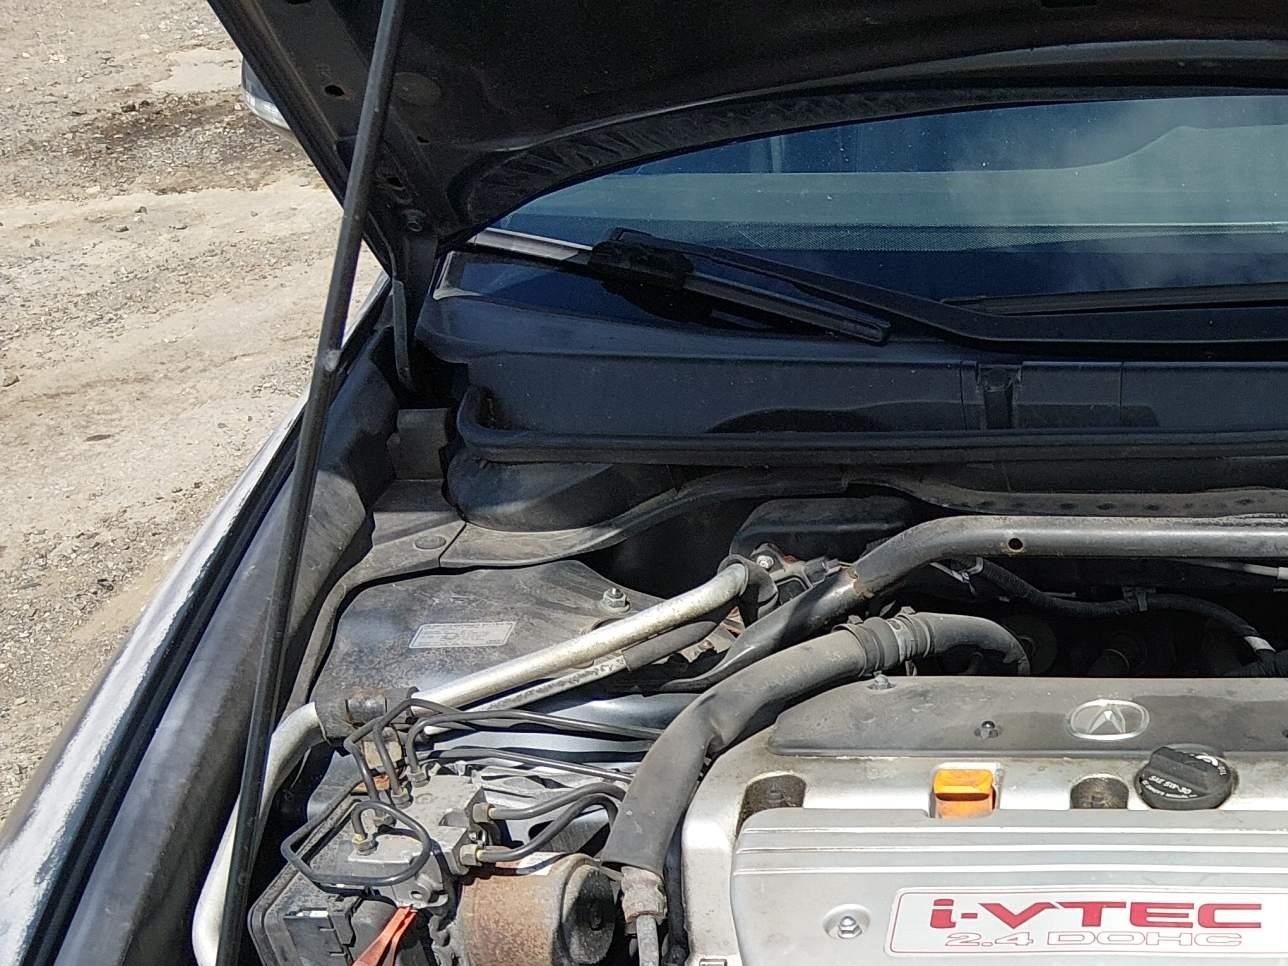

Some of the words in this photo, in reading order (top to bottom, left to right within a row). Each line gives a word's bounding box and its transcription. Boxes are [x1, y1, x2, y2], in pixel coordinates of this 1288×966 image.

[930, 898, 1262, 929] i-VTEC
[945, 930, 1034, 947] 2.4
[1047, 930, 1242, 947] DOHC
